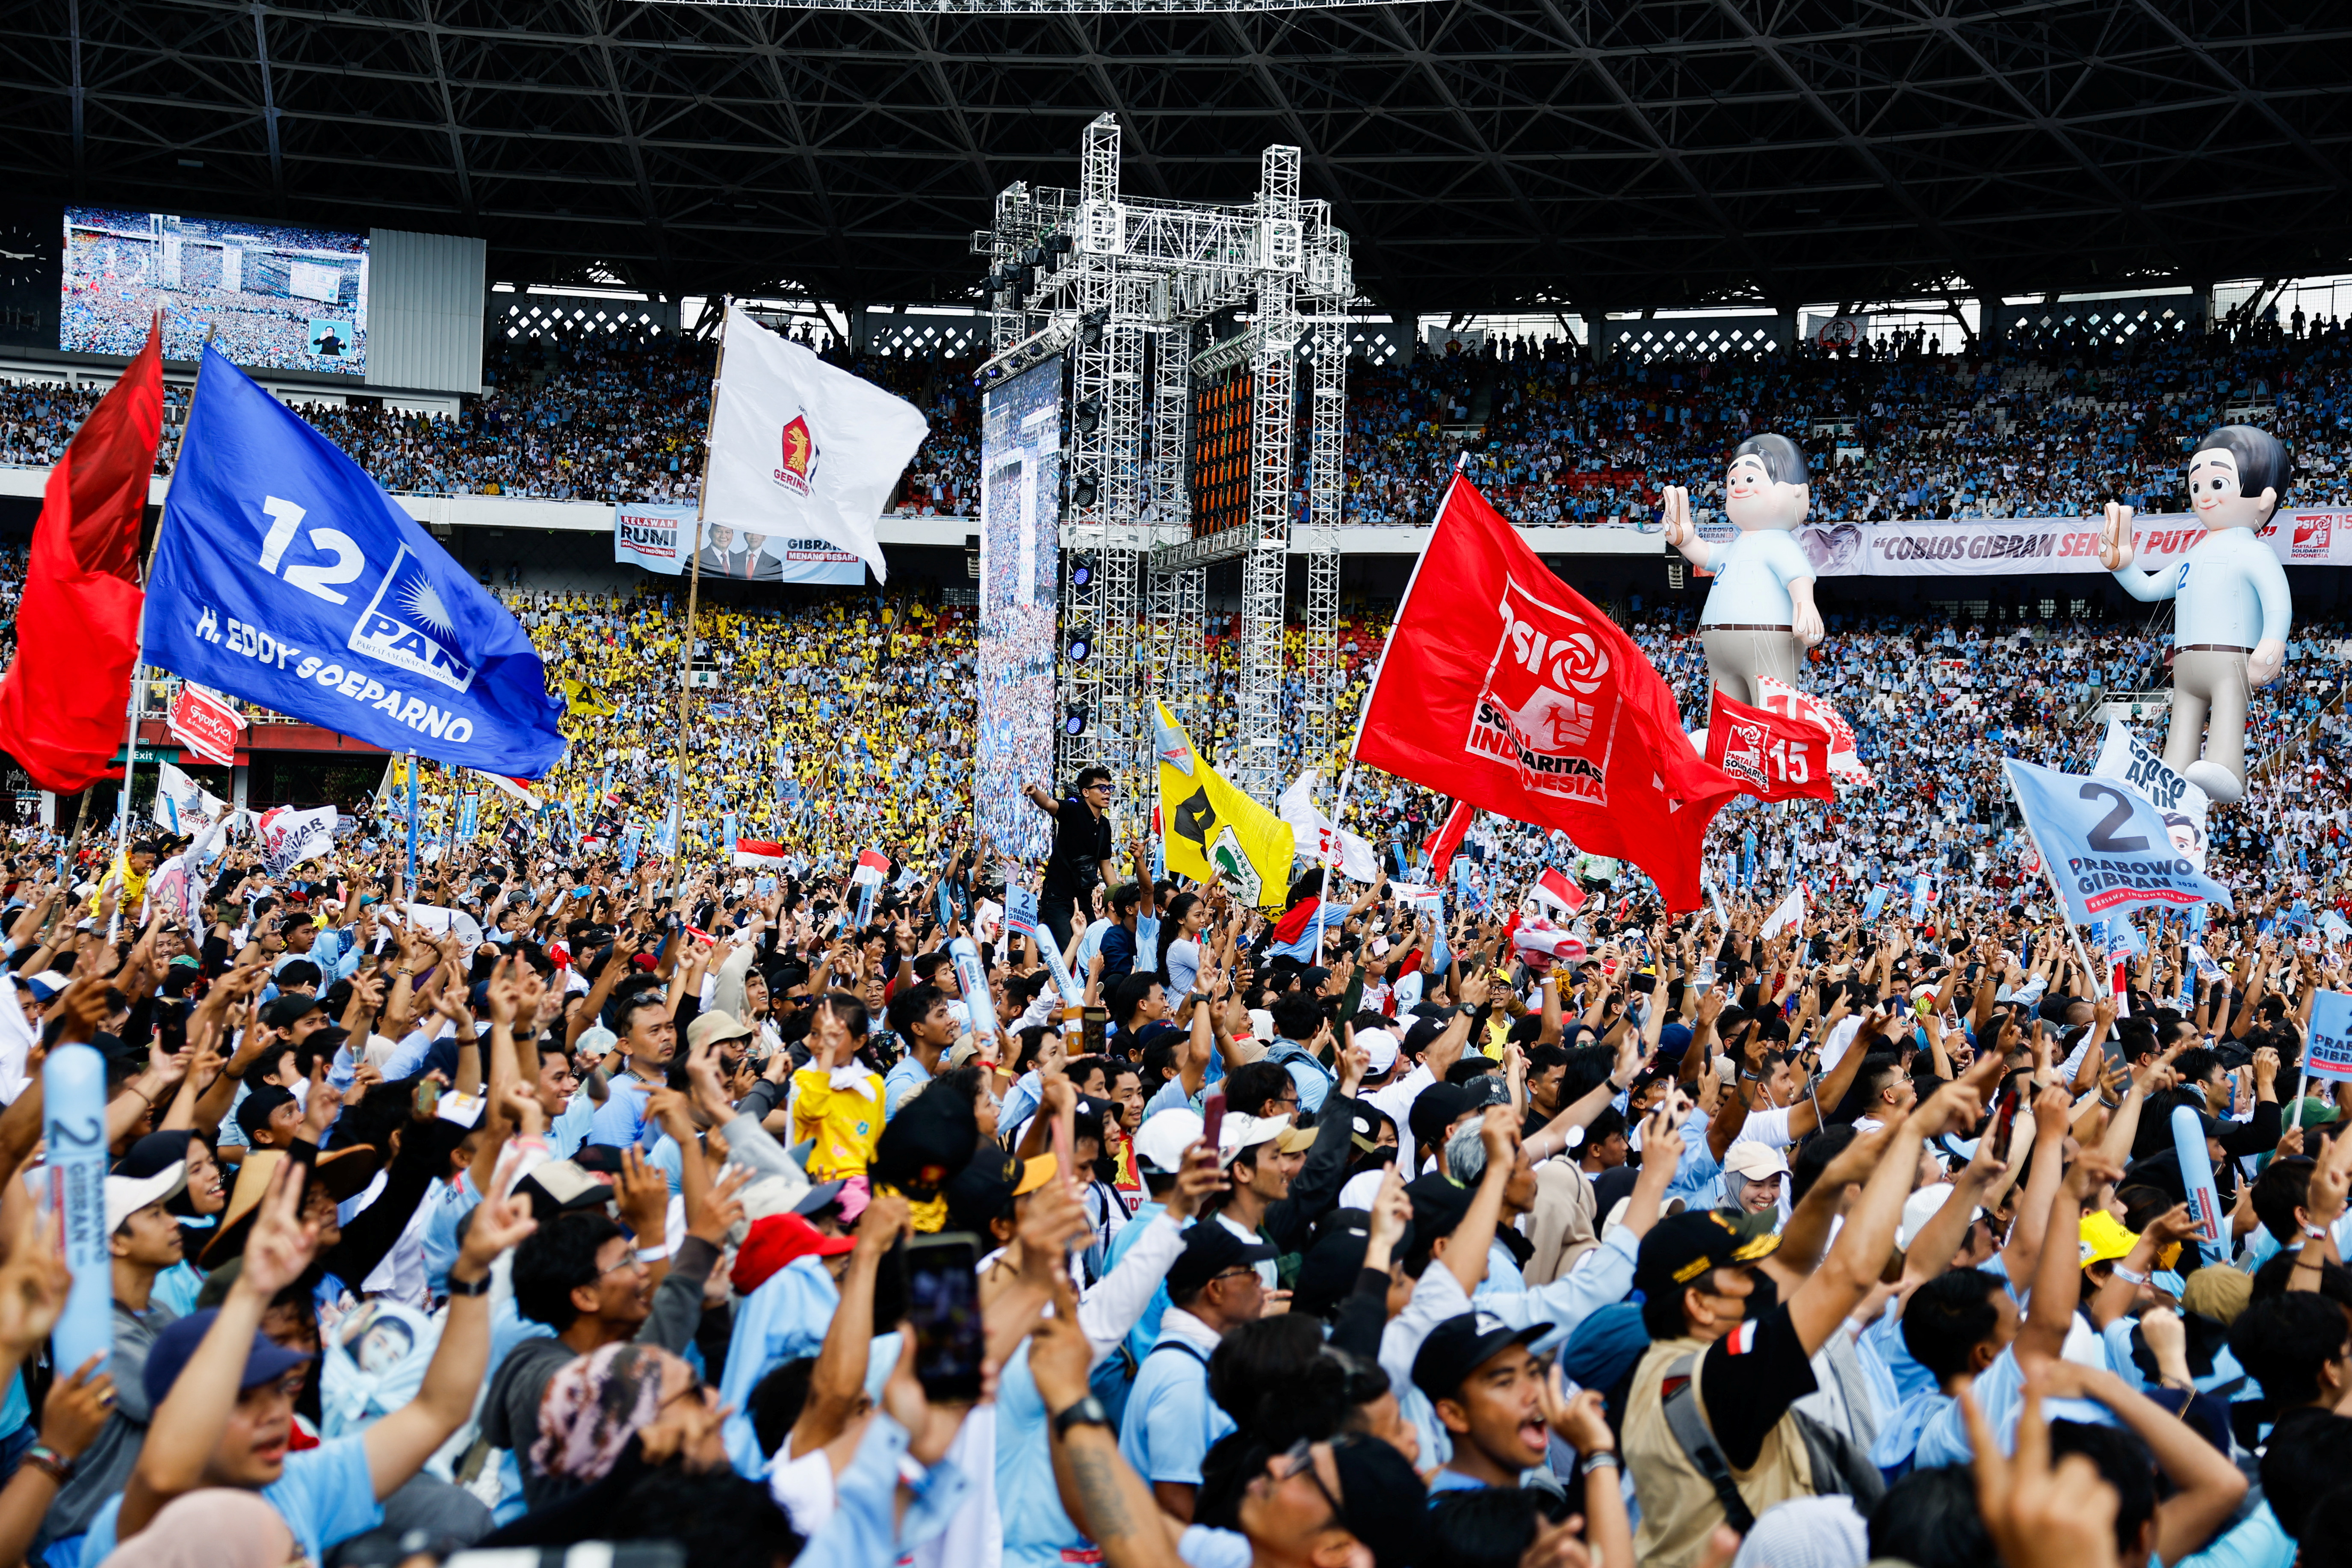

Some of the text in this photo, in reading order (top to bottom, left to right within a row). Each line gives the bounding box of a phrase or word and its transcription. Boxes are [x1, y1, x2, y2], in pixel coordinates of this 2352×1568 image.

[523, 294, 636, 310] SEKTOR 19
[2032, 297, 2159, 314] SEKTOR 21
[1357, 324, 1372, 333] 20
[773, 479, 789, 490] GERAKAN
[624, 517, 673, 527] RELAWAN
[2295, 514, 2352, 530] PSI 15
[621, 523, 677, 546] RUMI
[258, 496, 365, 605] 12
[1968, 533, 2057, 559] GIBRAN
[2057, 531, 2142, 557] SEKI
[789, 552, 856, 561] MENANG BESAR!
[1712, 562, 1726, 587] 2
[2177, 562, 2190, 591] 2
[360, 613, 475, 681] PAN
[355, 639, 461, 688] PARTAI AMANAT NASIONAL
[196, 606, 474, 743] H. EDDY SOEPARNO
[576, 686, 595, 708] 4
[190, 705, 231, 742] GATOTKACA
[133, 750, 153, 760] Exit
[1470, 724, 1605, 803] INDNESIA
[1726, 752, 1752, 767] PARTAI
[1770, 738, 1809, 784] 15
[465, 797, 473, 835] PRABOWO
[2079, 783, 2151, 852] 2
[2068, 857, 2194, 877] PRABOWO
[2078, 872, 2172, 895] GIBRAN
[1021, 894, 1030, 909] 2
[1915, 887, 1927, 904] 2
[2091, 892, 2125, 908] BERSAMA
[1009, 907, 1036, 921] PRABOWO
[1009, 914, 1031, 925] GIBRAN
[322, 956, 337, 967] 2
[1047, 959, 1061, 989] GIBRAN
[1051, 956, 1070, 989] PRABOWO
[1401, 990, 1413, 1001] 2
[2314, 1034, 2352, 1051] PRAB
[2312, 1046, 2352, 1063] GIBR
[2312, 1062, 2337, 1070] BERSAMA
[50, 1117, 101, 1149] 2
